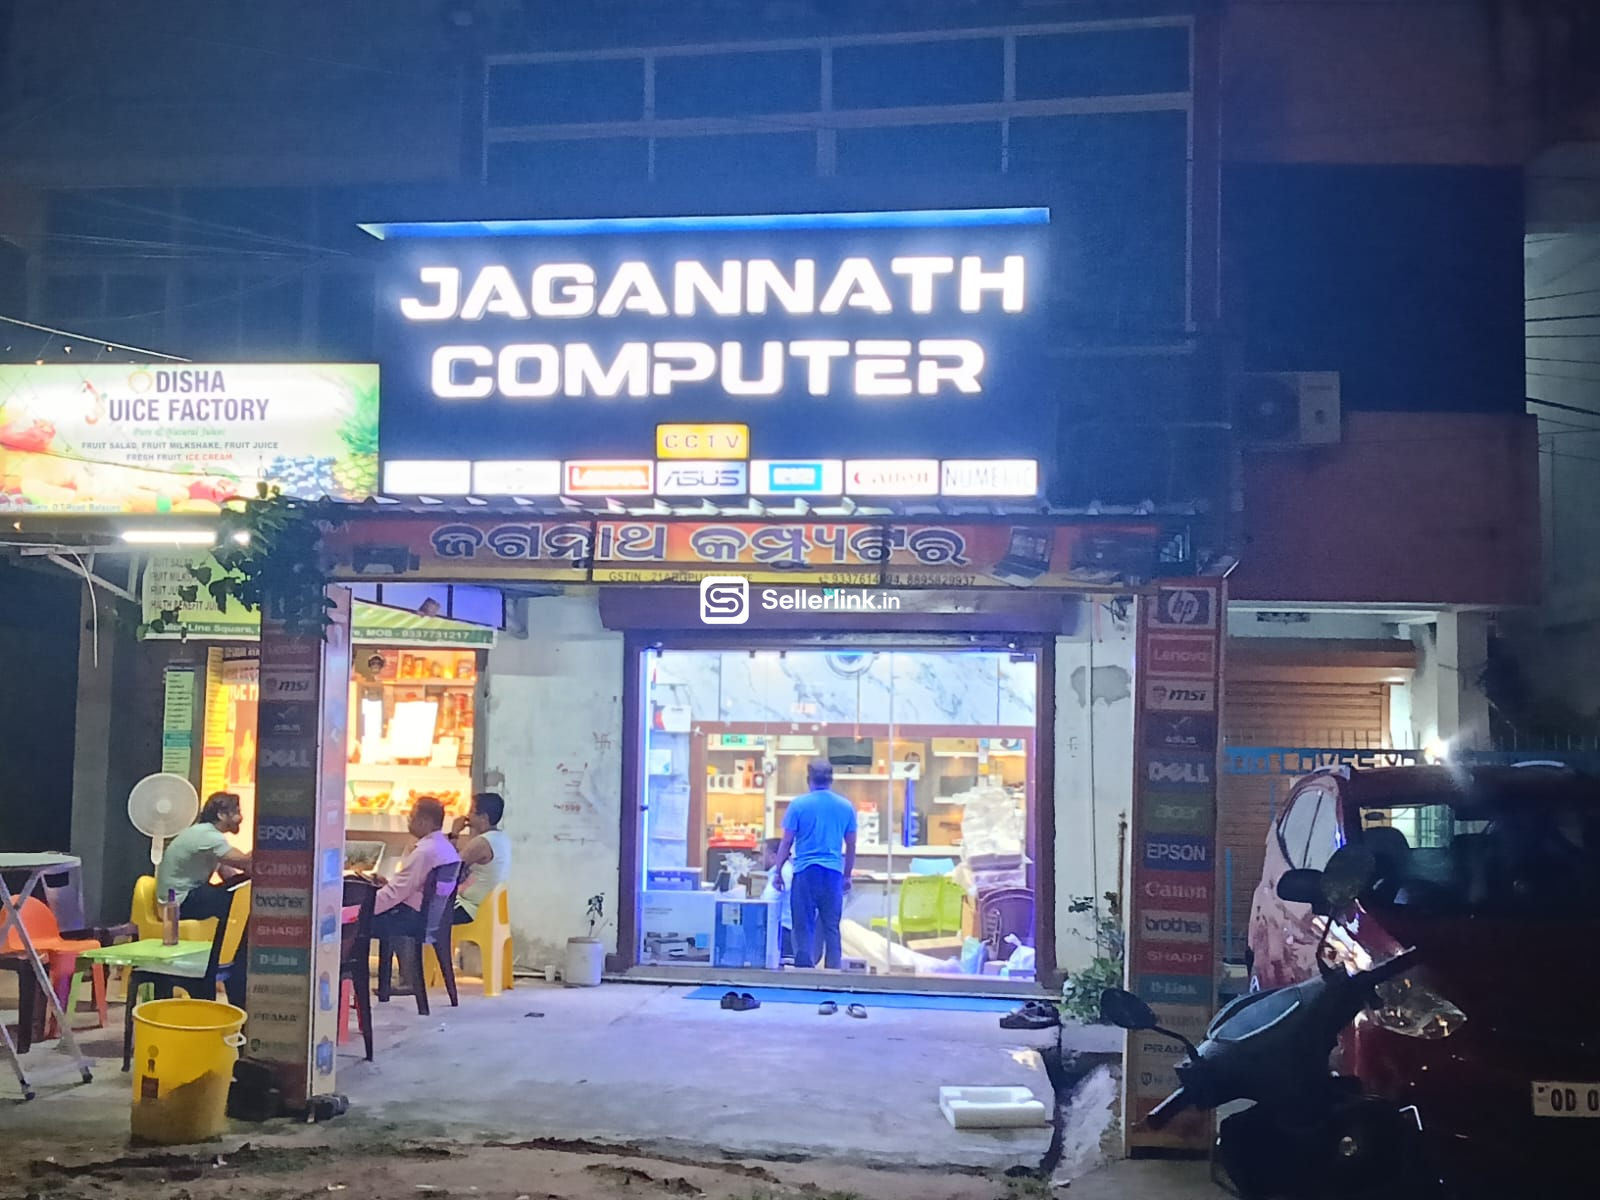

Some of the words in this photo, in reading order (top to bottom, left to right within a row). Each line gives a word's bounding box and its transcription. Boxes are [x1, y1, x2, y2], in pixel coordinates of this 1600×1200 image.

[400, 255, 1026, 321] JAGANNATH
[431, 339, 986, 398] COMPUTER
[168, 399, 269, 421] FACTORY
[664, 434, 739, 449] CCTV
[664, 470, 740, 486] ASUS
[609, 570, 643, 582] GSTIN
[188, 624, 211, 632] Line
[366, 629, 393, 637] MOB
[278, 679, 310, 691] msi
[1169, 689, 1207, 700] msi
[1148, 761, 1209, 783] DELL
[258, 825, 306, 841] EPSON
[1147, 843, 1206, 861] EPSON
[1144, 881, 1208, 898] Canon
[255, 893, 305, 909] brother
[256, 926, 303, 937] SHARP
[1145, 915, 1202, 934] brother
[1146, 951, 1204, 963] SHARP
[1551, 1088, 1577, 1112] OD
